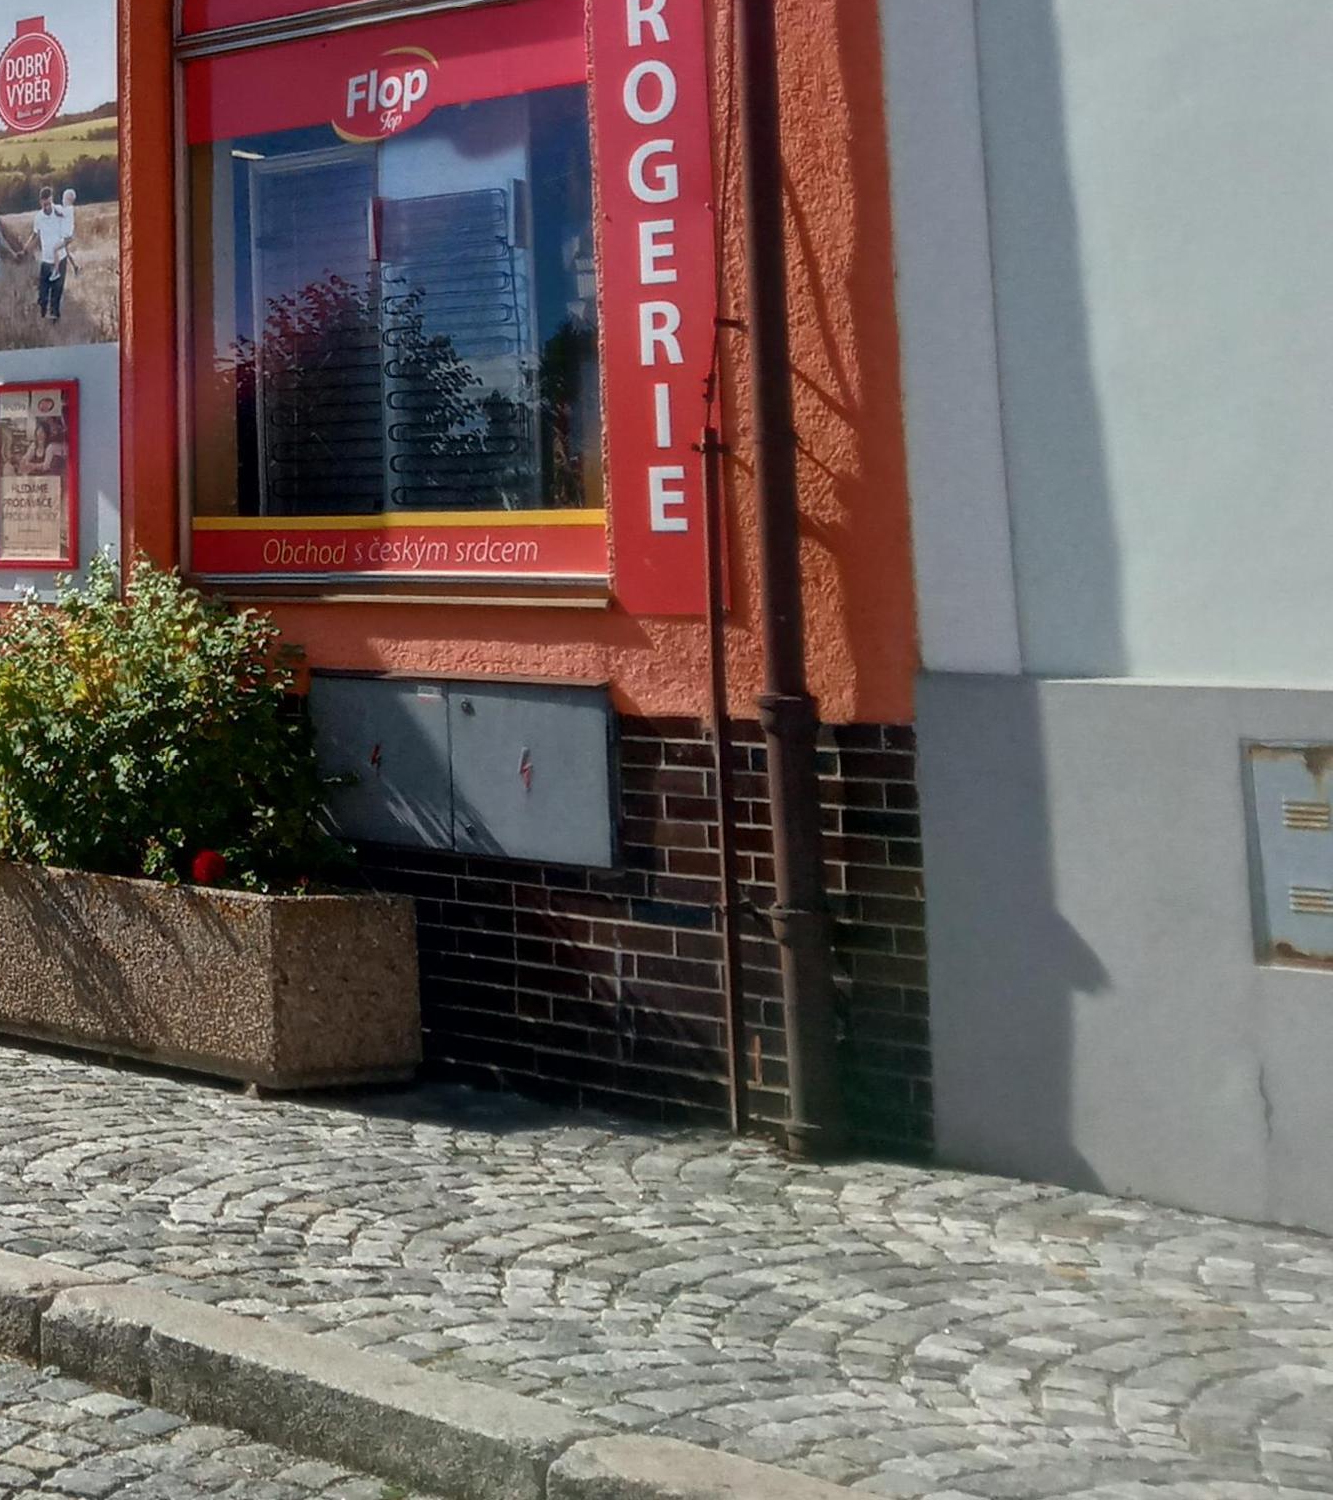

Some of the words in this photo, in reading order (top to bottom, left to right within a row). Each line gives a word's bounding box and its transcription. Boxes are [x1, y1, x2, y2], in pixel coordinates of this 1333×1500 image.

[5, 46, 53, 82] DOBRÝ
[5, 75, 52, 108] VÝBĚR
[346, 68, 429, 119] Flop
[379, 108, 403, 133] Top
[263, 537, 347, 565] Obchod
[353, 542, 364, 565] s
[369, 535, 449, 569] českým
[455, 535, 539, 563] srdcem
